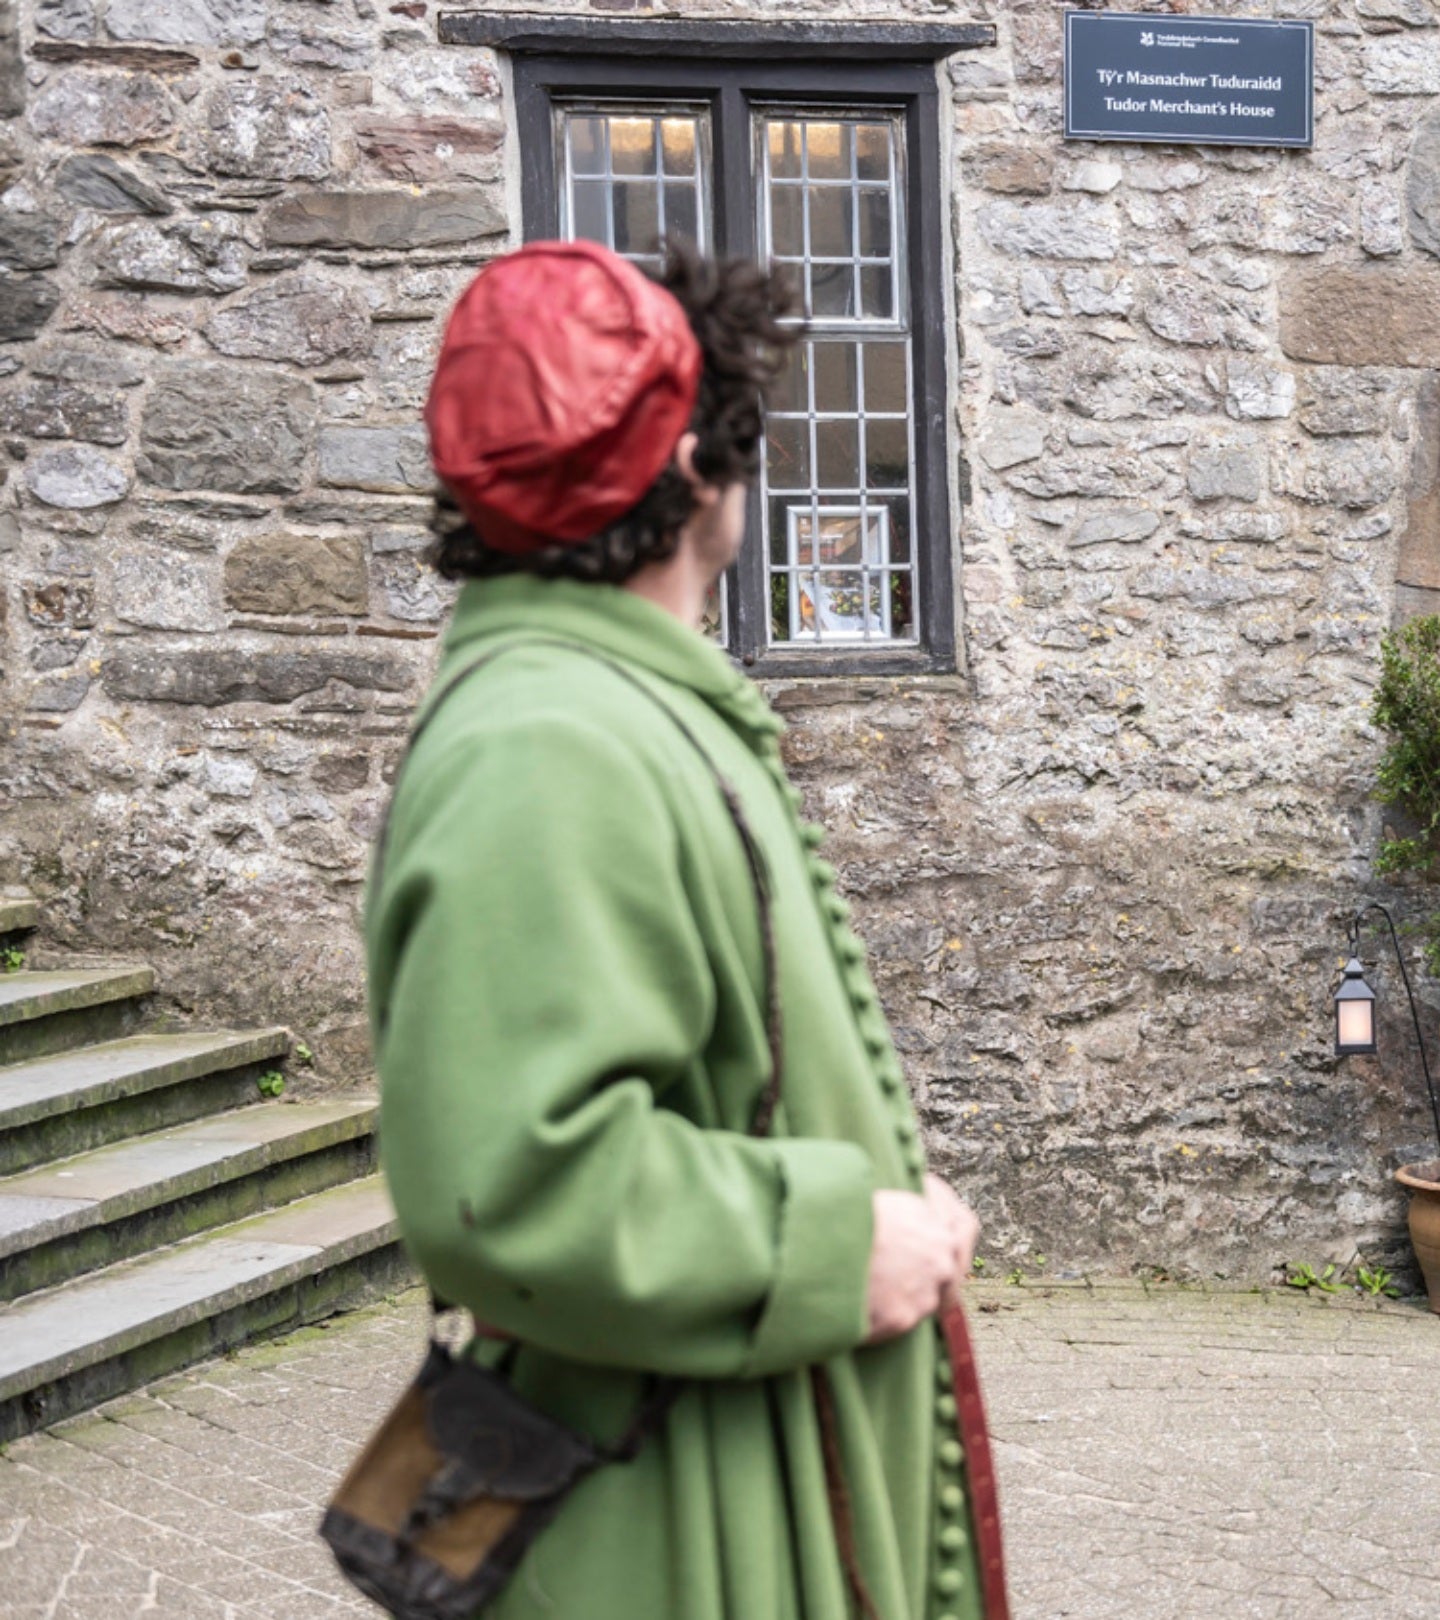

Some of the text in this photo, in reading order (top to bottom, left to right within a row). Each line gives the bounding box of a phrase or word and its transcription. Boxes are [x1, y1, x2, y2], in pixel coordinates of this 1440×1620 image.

[1126, 71, 1207, 88] Masnachwr
[1209, 74, 1282, 91] Tuduraidd
[1104, 97, 1275, 118] Tudor Merchant's House
